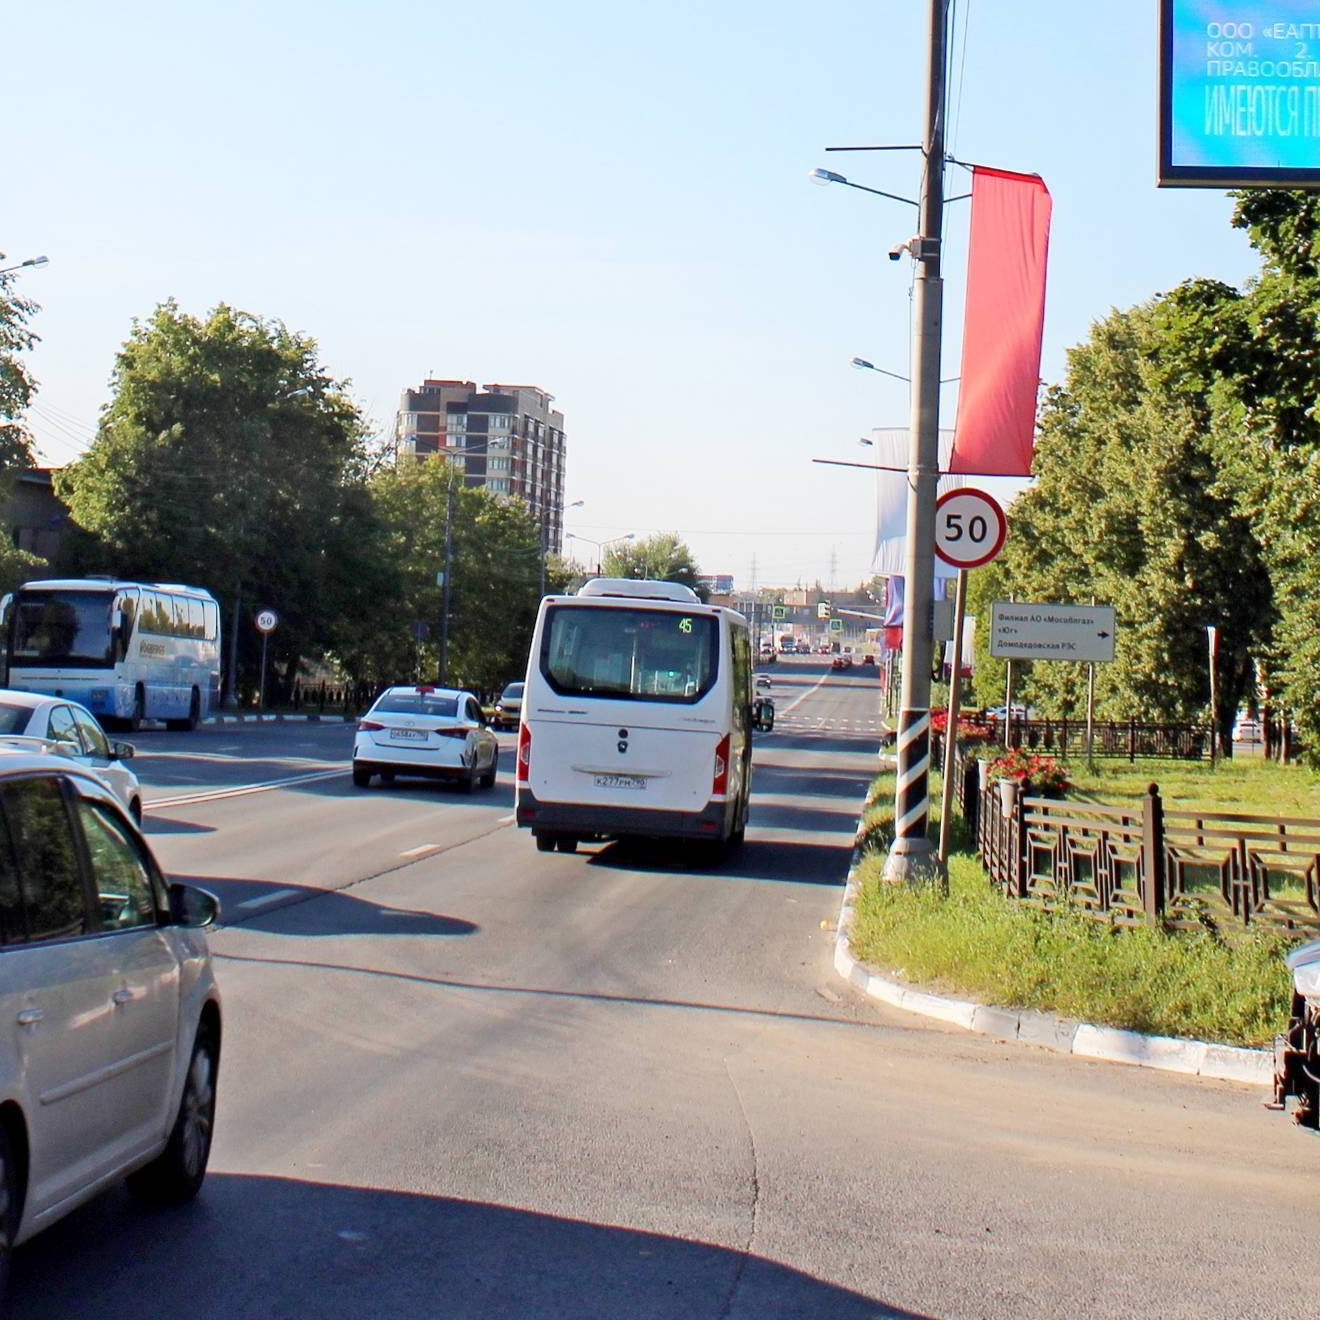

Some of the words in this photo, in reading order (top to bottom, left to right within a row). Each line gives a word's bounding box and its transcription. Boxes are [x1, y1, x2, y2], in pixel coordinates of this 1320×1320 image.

[1207, 23, 1253, 39] ООО
[1207, 42, 1257, 58] КОМ.
[1295, 42, 1311, 59] 2.
[1205, 84, 1299, 137] ИМЕЮТСЯ
[944, 513, 988, 544] 50
[679, 618, 693, 633] 45
